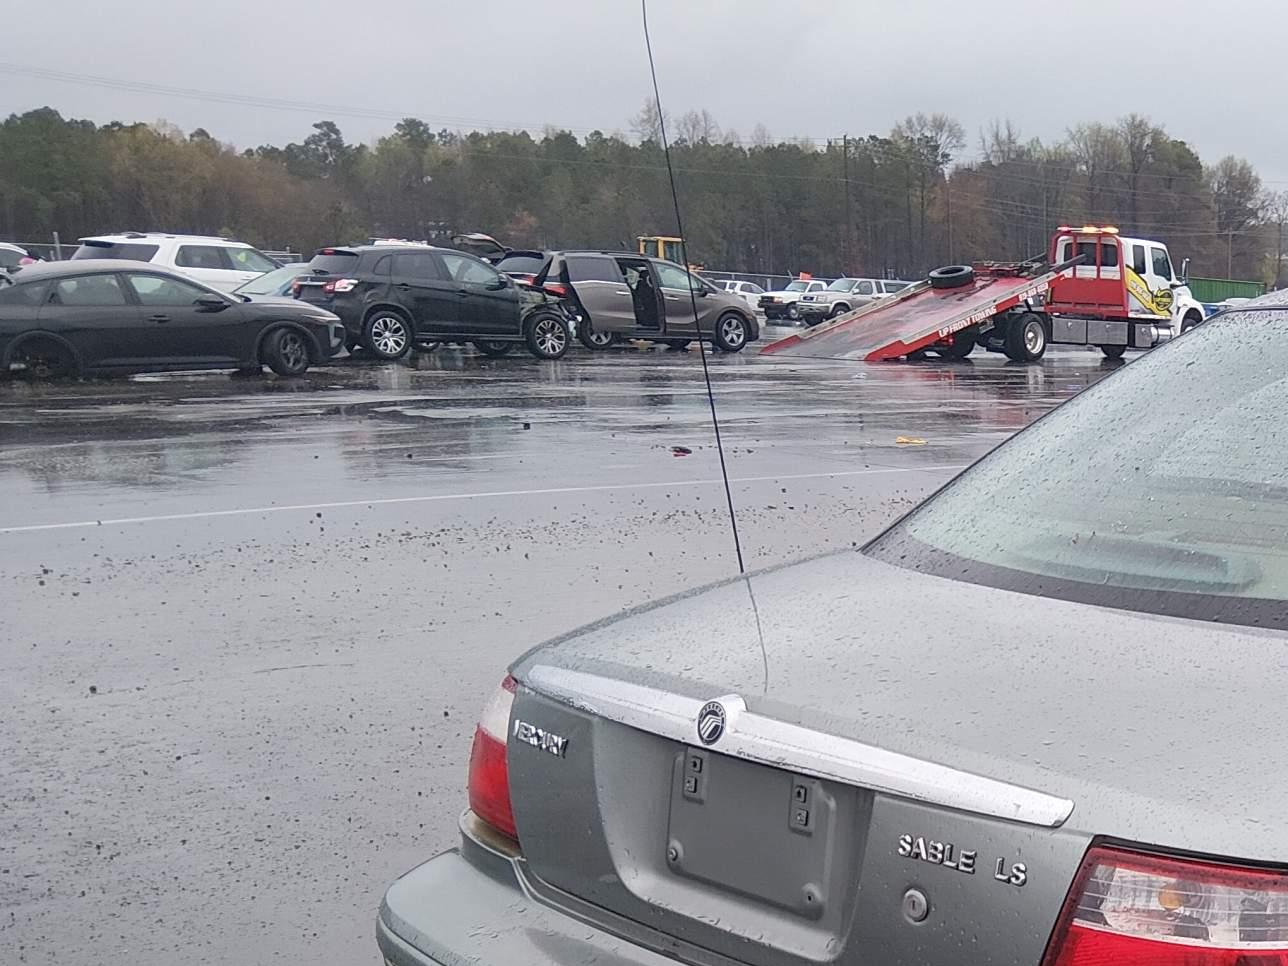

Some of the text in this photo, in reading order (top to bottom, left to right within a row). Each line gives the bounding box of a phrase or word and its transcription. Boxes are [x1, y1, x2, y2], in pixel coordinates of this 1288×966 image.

[938, 305, 998, 338] UP FRONT TOWING
[898, 834, 1028, 887] SABLE LS
